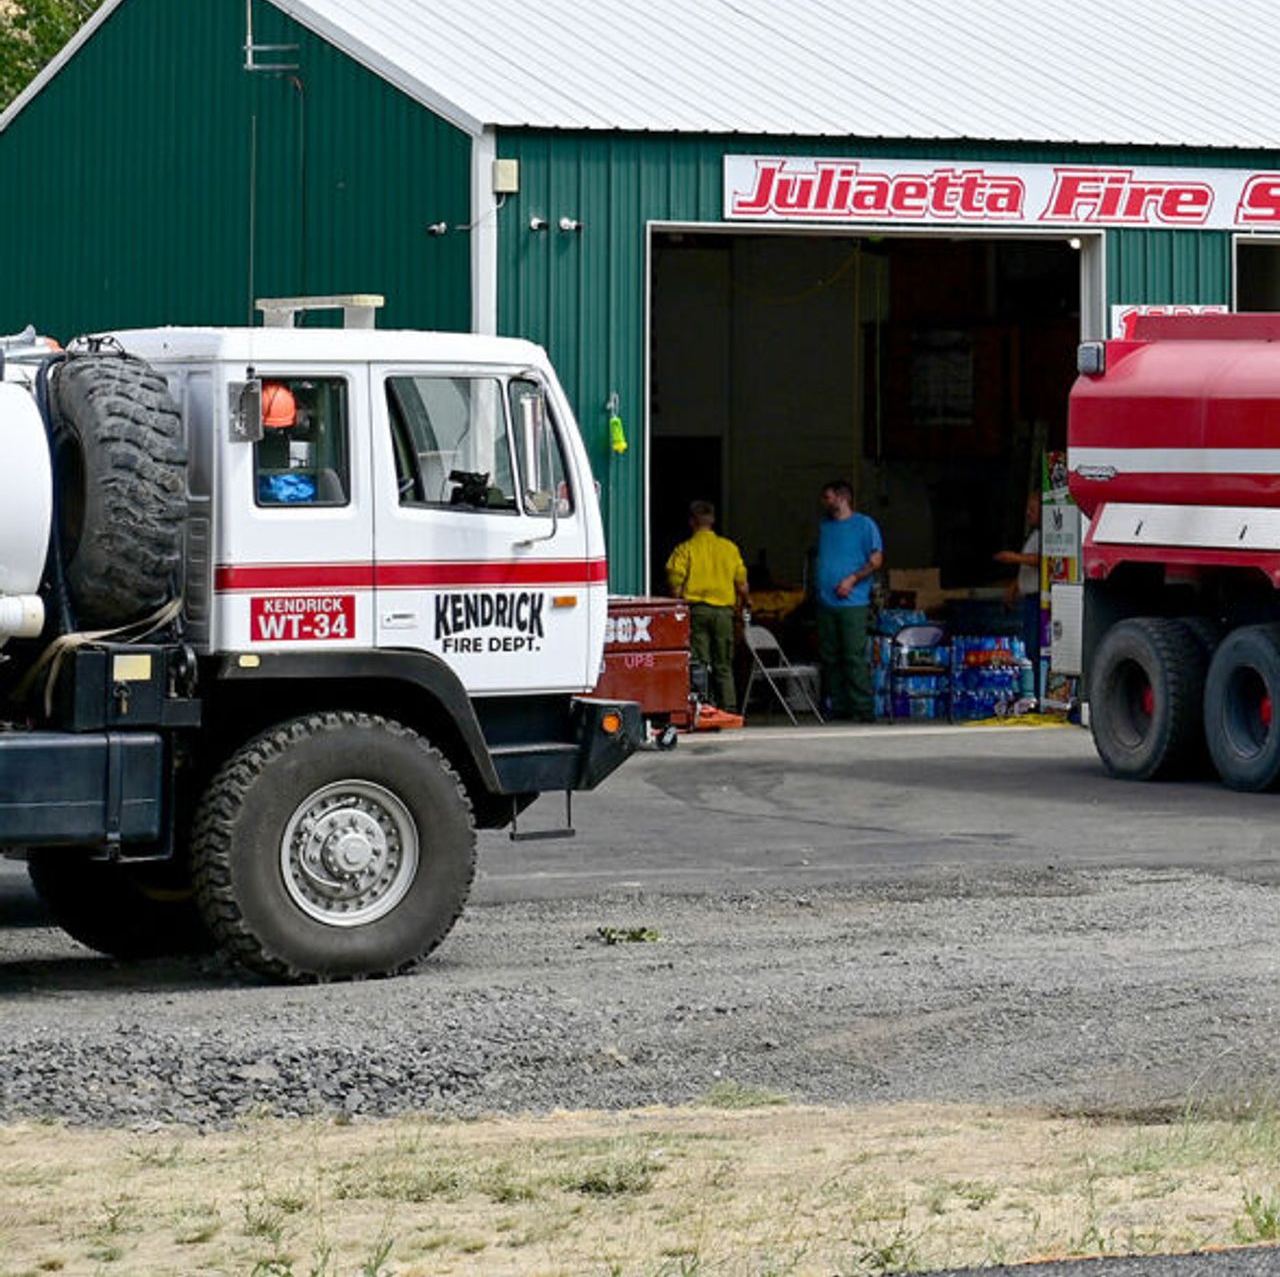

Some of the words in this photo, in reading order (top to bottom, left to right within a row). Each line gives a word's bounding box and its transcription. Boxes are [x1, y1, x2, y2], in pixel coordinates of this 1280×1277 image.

[732, 160, 1025, 219] Juliaetta
[1039, 168, 1215, 224] Fire
[263, 597, 343, 614] KENDRICK
[435, 592, 544, 640] KENDRICK
[258, 613, 348, 639] WT-34
[443, 637, 482, 653] FIRE
[489, 636, 541, 652] DEPT.
